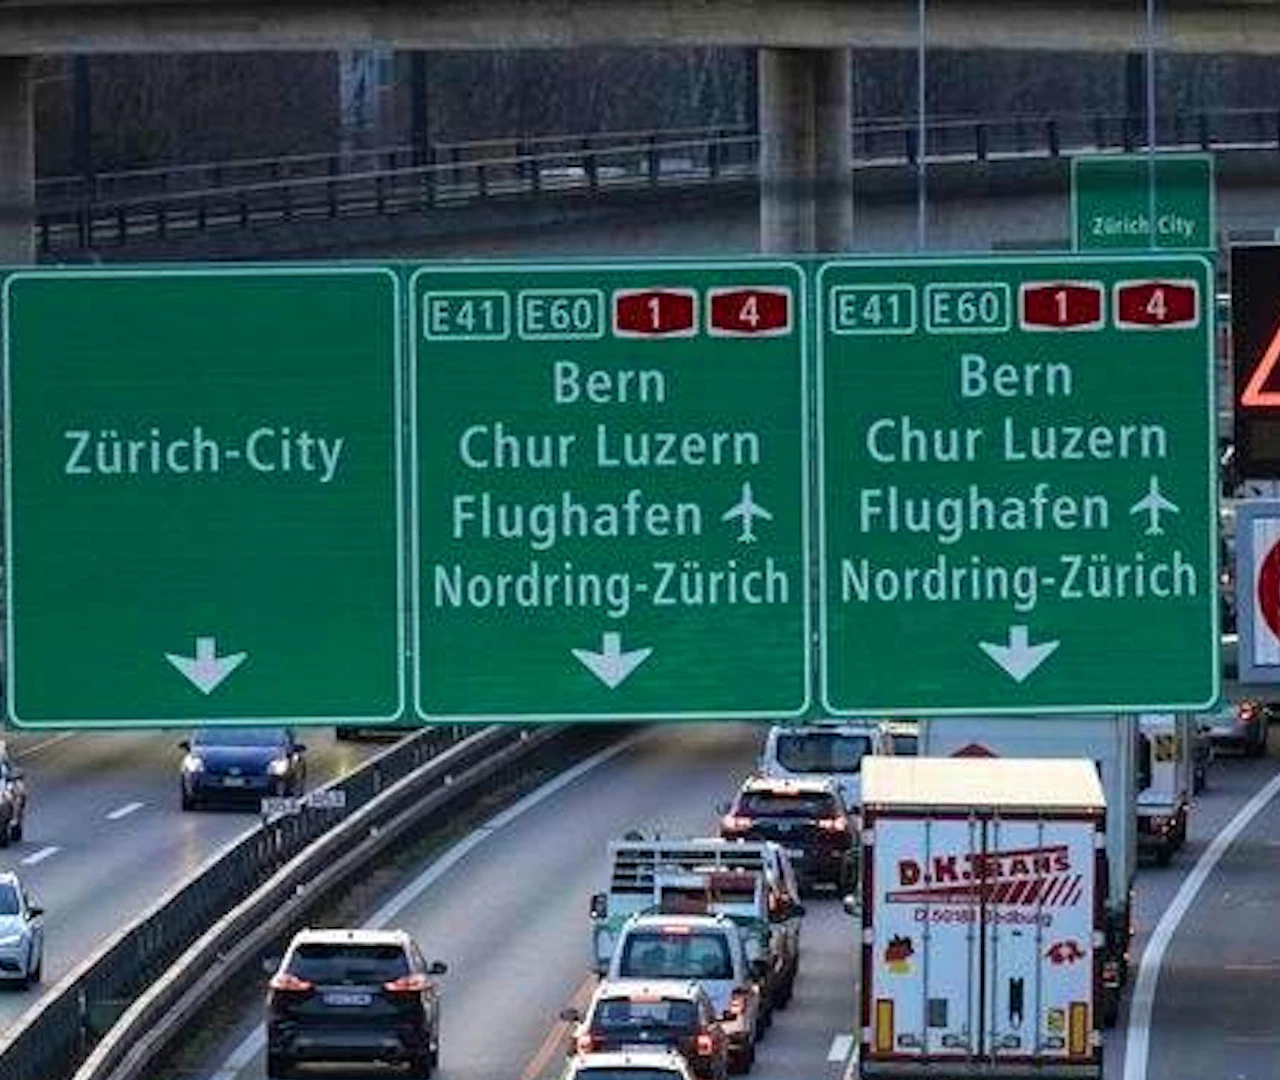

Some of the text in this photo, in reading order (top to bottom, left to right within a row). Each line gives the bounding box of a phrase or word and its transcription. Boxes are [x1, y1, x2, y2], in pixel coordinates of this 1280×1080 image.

[1157, 214, 1196, 237] City
[432, 297, 760, 332] E41 E60 1 4
[839, 289, 1166, 326] E41 E60 1 4
[554, 361, 665, 403] Bern
[961, 354, 1071, 397] Bern
[64, 427, 344, 482] Zürich-City
[460, 423, 760, 469] Chur Luzern
[867, 416, 1167, 462] Chur Luzern
[453, 489, 701, 551] Flughafen
[860, 483, 1108, 542] Flughafen
[434, 558, 789, 618] Nordring-Zürich
[842, 550, 1197, 611] Nordring-Zürich
